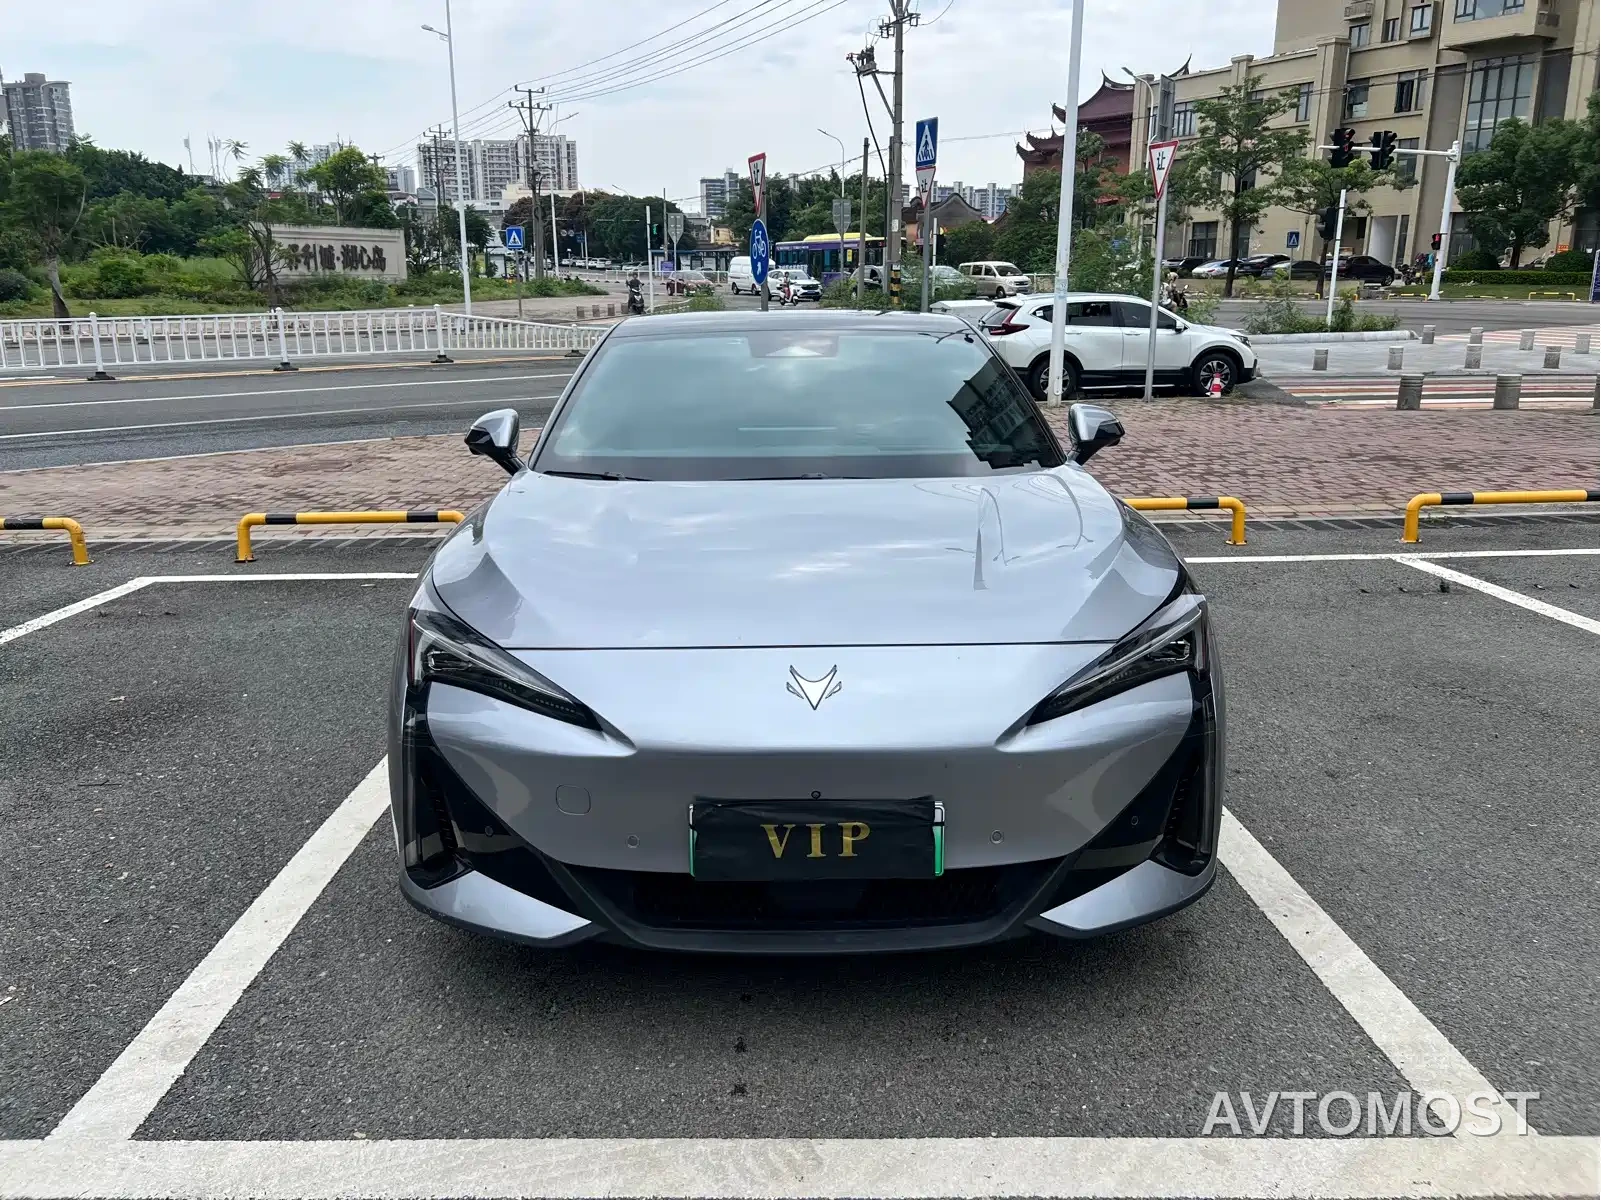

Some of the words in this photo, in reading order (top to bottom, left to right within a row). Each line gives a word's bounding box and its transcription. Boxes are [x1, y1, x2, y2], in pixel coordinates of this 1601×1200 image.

[1157, 151, 1166, 171] 让
[753, 162, 761, 186] 让
[760, 821, 871, 859] VIP
